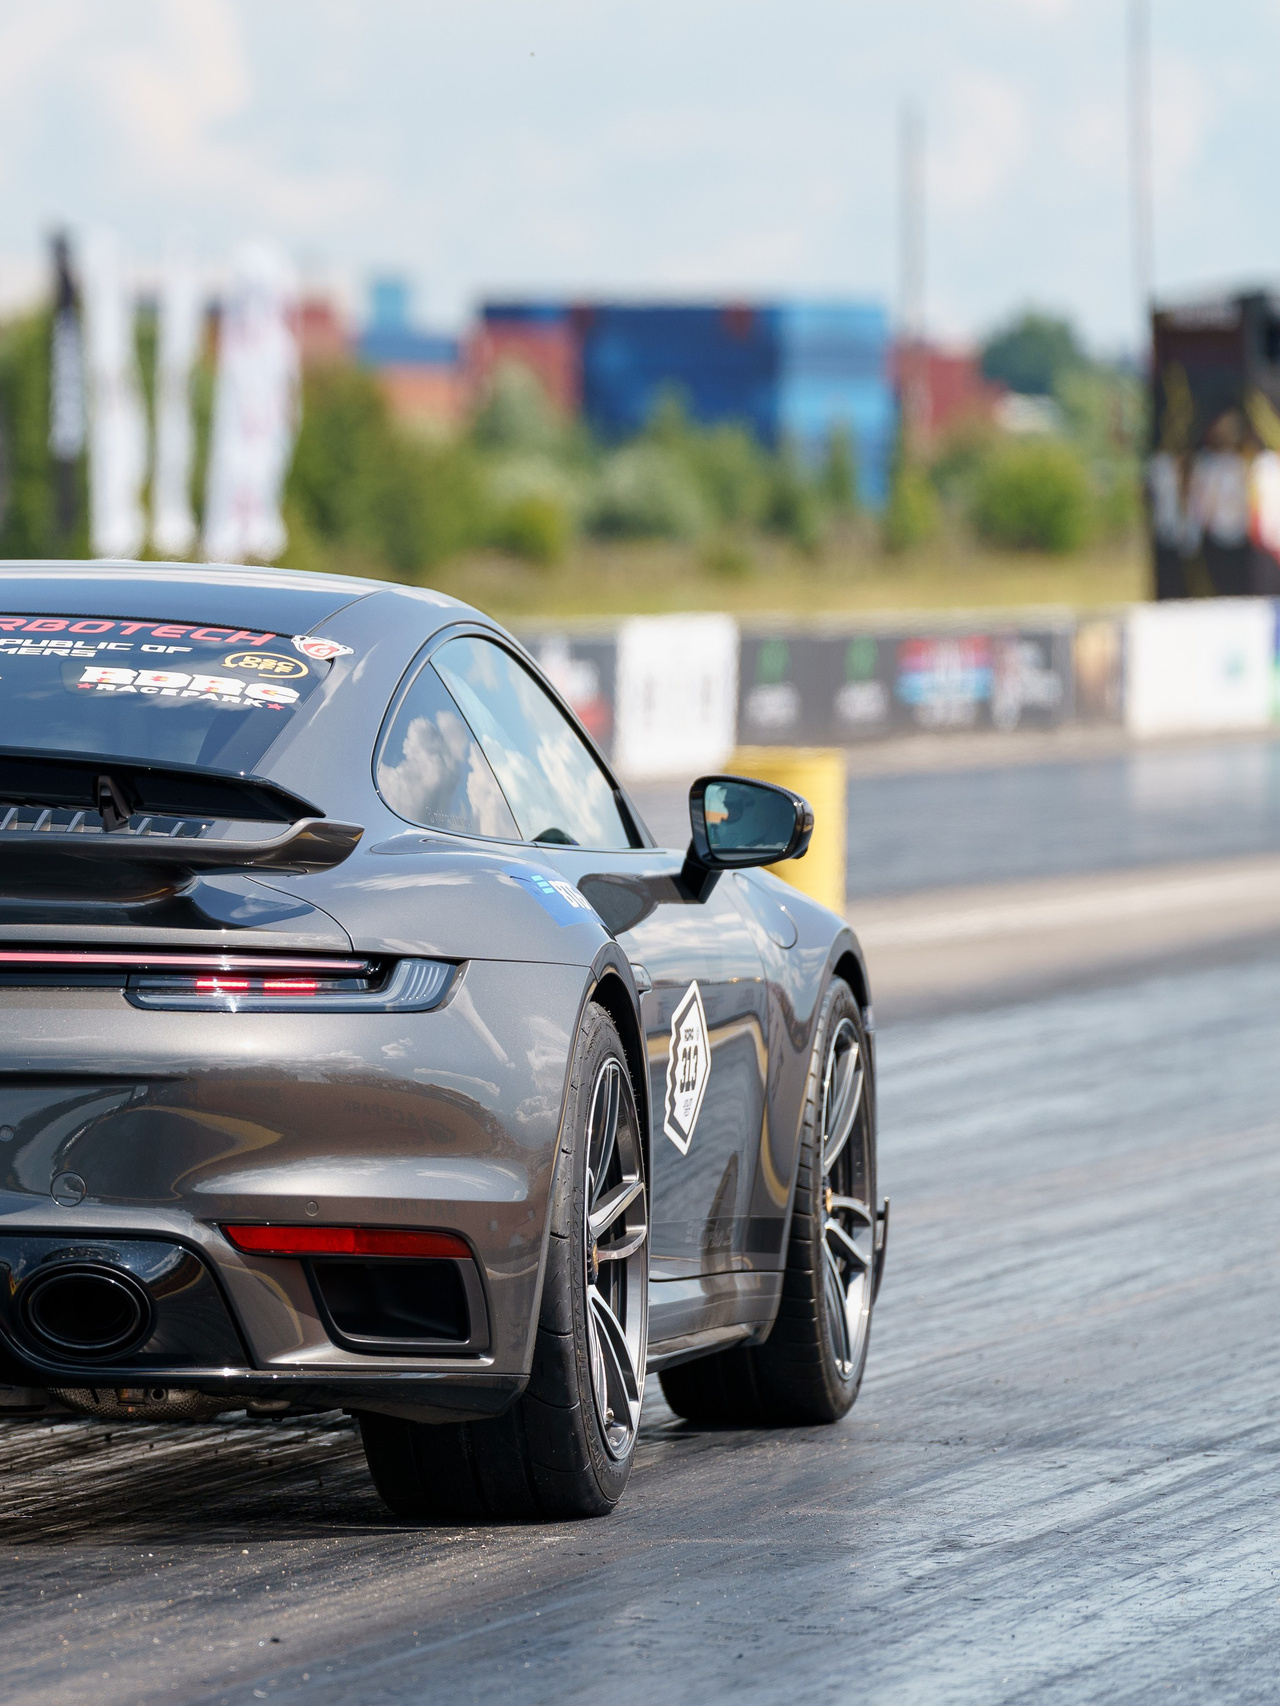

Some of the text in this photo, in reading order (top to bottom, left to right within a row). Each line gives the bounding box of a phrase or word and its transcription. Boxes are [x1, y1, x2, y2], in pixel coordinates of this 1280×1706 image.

[139, 645, 193, 654] OF
[237, 661, 293, 674] OFF
[242, 655, 295, 668] DSC
[95, 683, 268, 708] RACEPARK
[679, 1045, 699, 1094] 313
